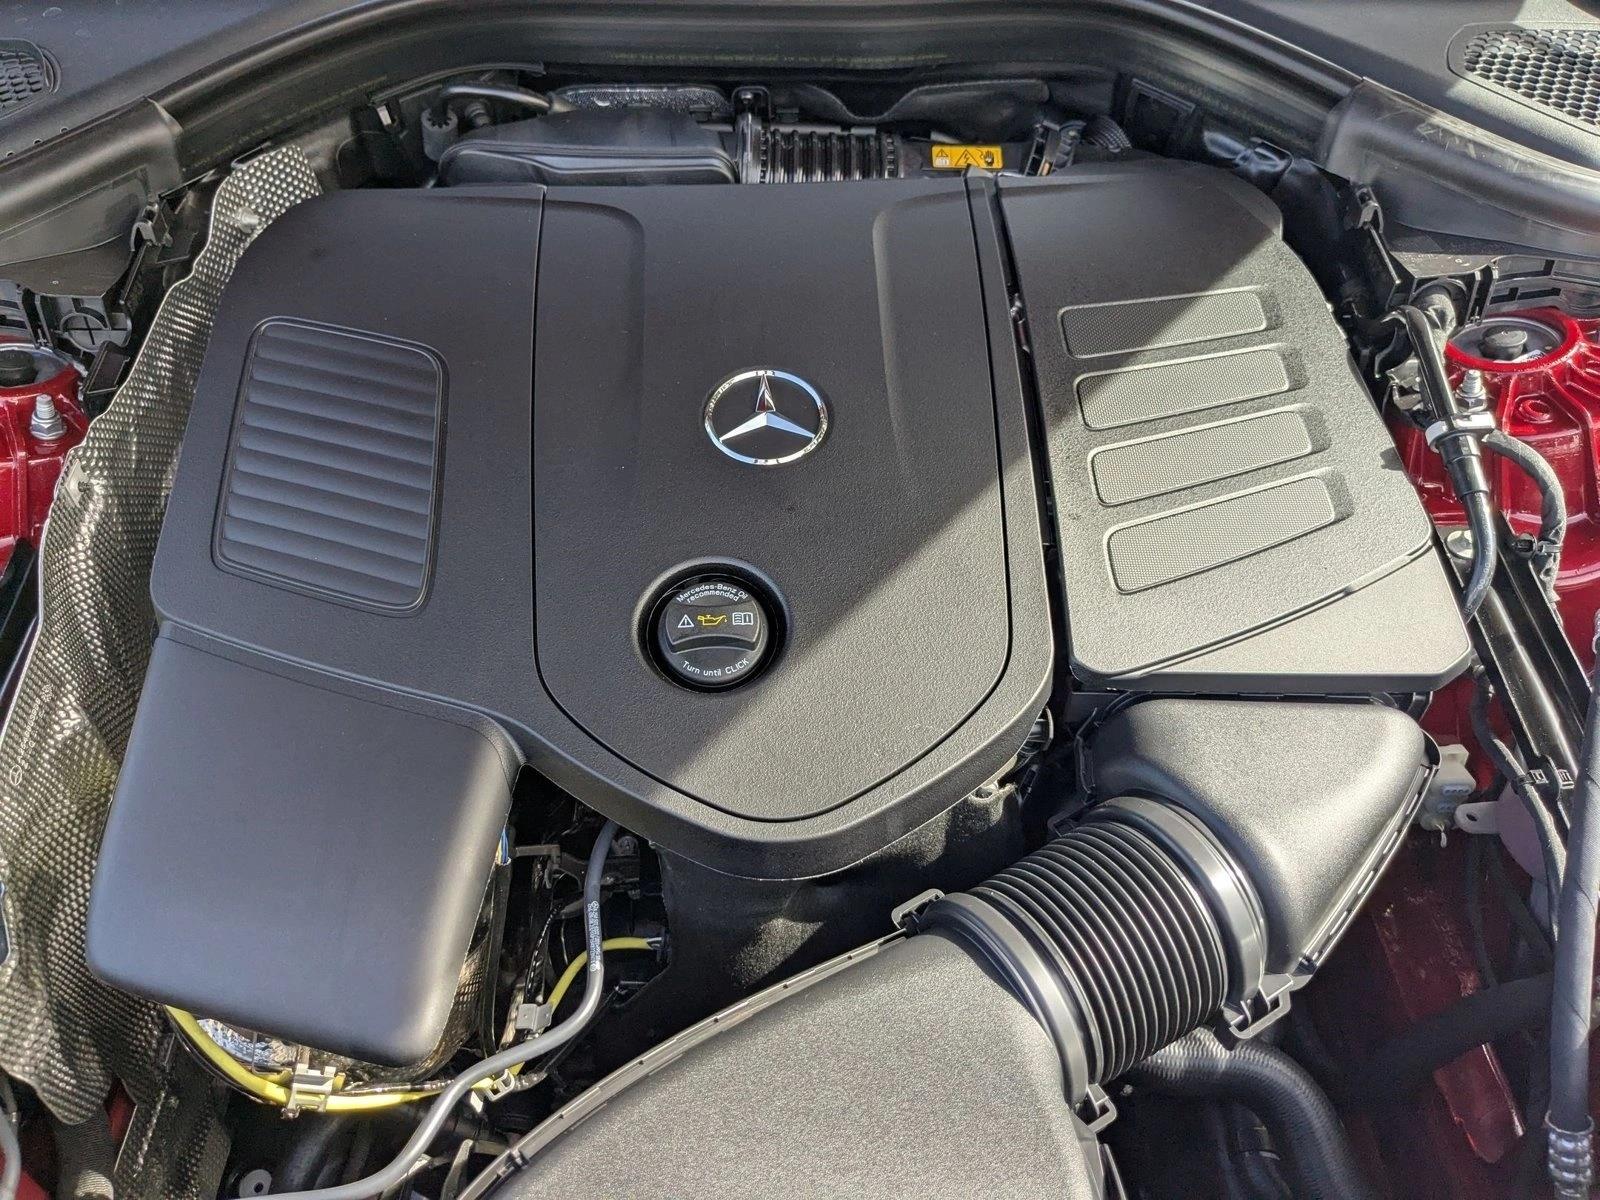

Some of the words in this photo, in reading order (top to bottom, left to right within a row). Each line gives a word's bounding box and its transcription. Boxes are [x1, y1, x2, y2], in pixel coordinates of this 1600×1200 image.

[676, 583, 737, 603] Mercedes-Benz
[738, 591, 749, 600] Oil
[686, 589, 740, 603] recommended
[682, 660, 700, 674] Turn
[703, 668, 722, 676] until
[725, 657, 750, 674] CLICK
